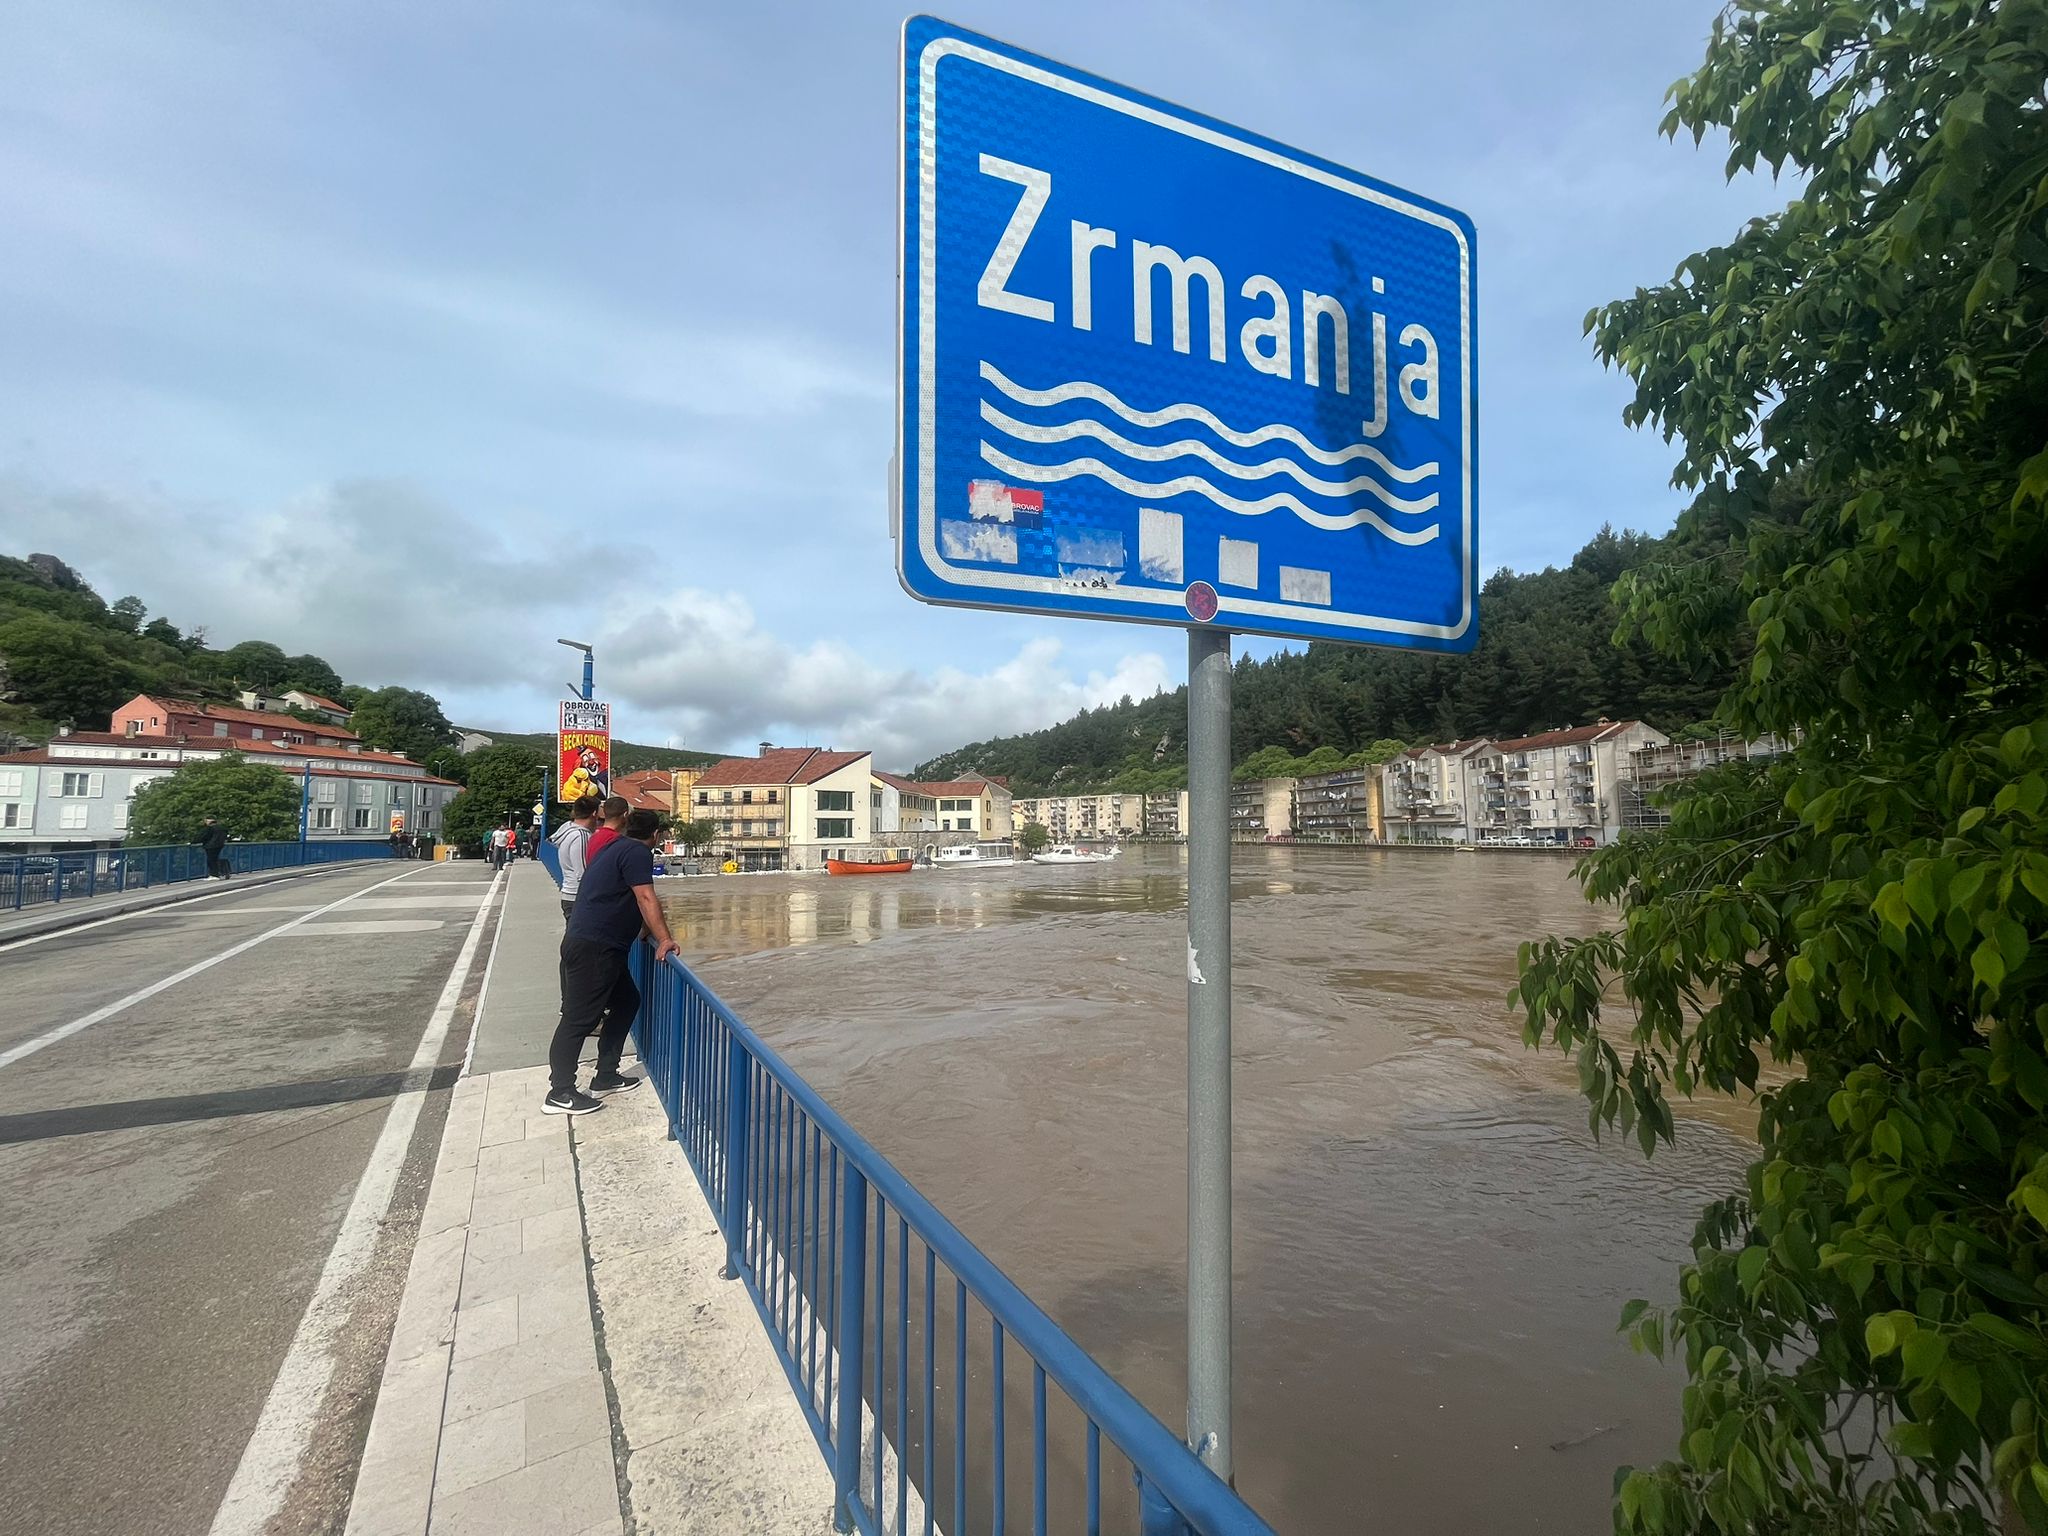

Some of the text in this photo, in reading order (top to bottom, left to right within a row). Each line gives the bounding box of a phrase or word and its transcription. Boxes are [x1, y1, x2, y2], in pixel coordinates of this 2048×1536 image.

[977, 152, 1439, 438] Zrmanja
[1011, 502, 1040, 512] BROVAC
[564, 701, 606, 711] OBROVAC
[583, 733, 606, 752] CIRKUS
